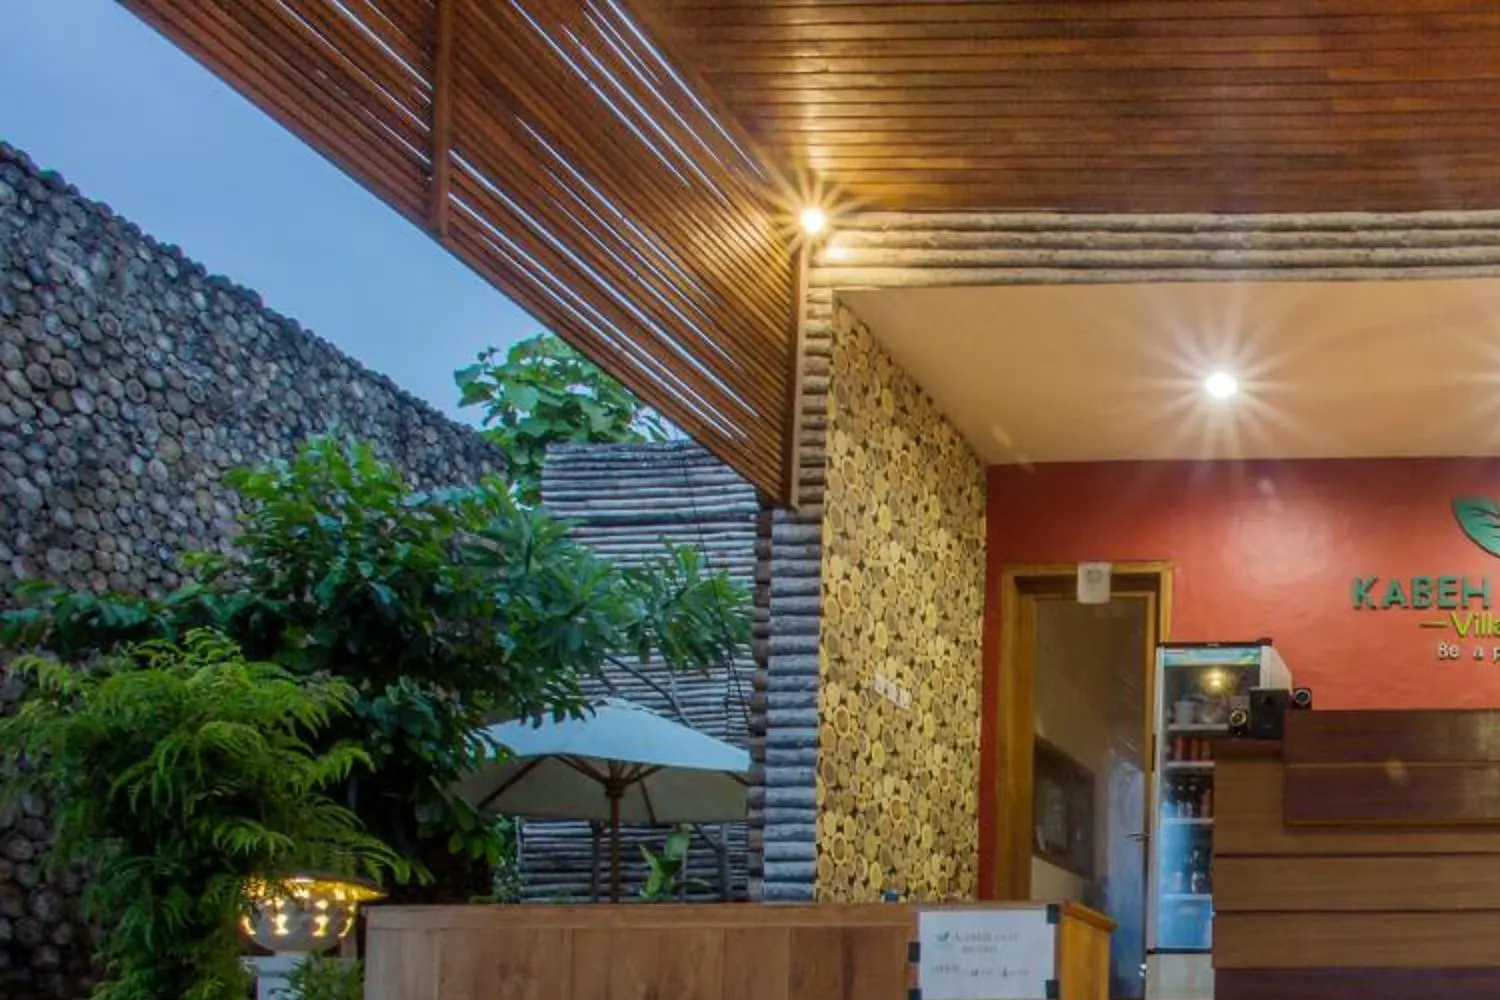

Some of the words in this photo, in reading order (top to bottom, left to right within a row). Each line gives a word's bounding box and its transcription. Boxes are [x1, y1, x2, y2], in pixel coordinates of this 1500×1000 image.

[1353, 575, 1490, 609] KABEH
[1438, 641, 1460, 660] Be
[1473, 646, 1484, 660] a
